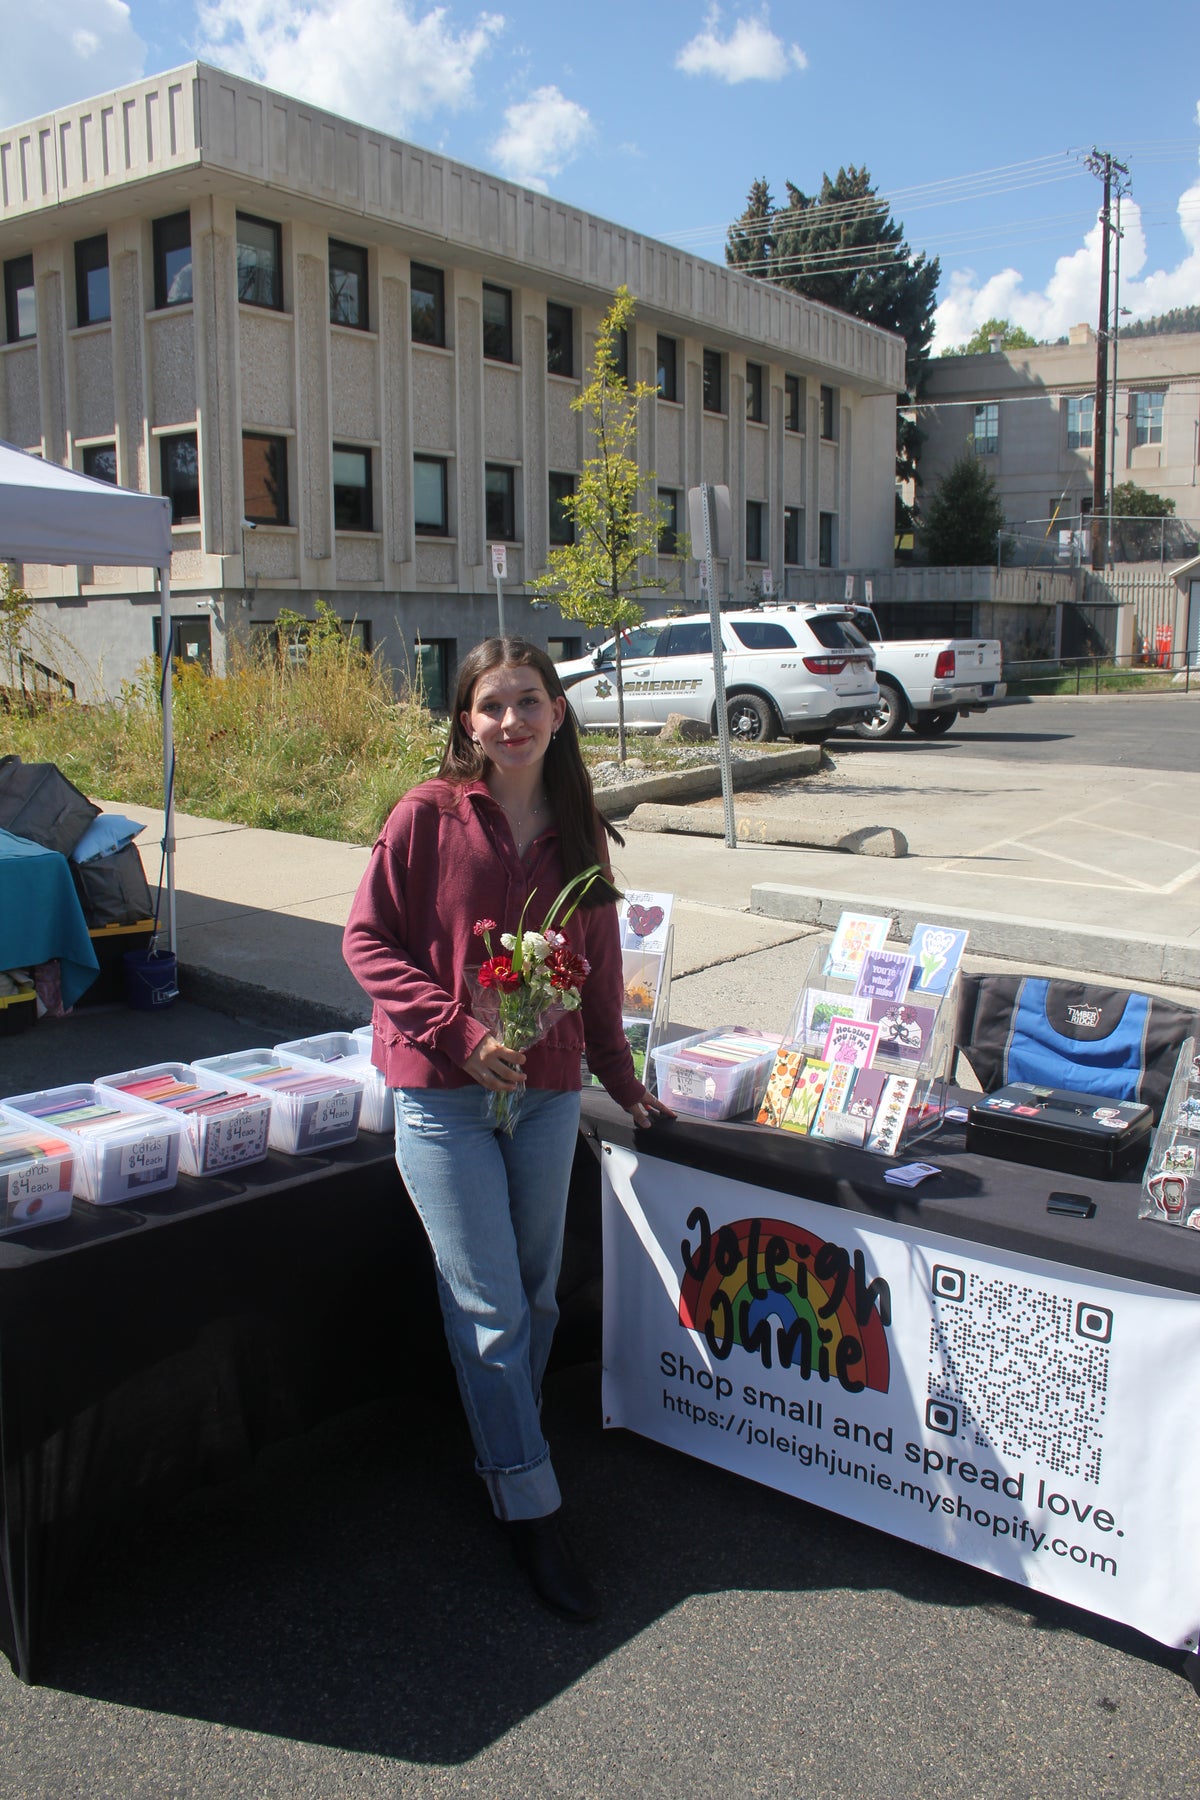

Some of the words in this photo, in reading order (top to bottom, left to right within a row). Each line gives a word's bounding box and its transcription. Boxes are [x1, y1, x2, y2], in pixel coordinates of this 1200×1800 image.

[623, 679, 703, 692] SHERIFF
[1067, 1008, 1096, 1020] TIMBER
[1070, 1014, 1096, 1026] RIDGE
[832, 1033, 848, 1046] YOU
[835, 1026, 871, 1041] HOLDING
[681, 1206, 891, 1326] Joleigh
[705, 1290, 865, 1393] Junie
[660, 1351, 733, 1400] Shop
[743, 1385, 822, 1429] small
[833, 1417, 893, 1454] and
[904, 1441, 1025, 1501] spread
[1037, 1479, 1125, 1538] love.
[663, 1389, 1118, 1577] https://joleighjunie.myshopify.com
